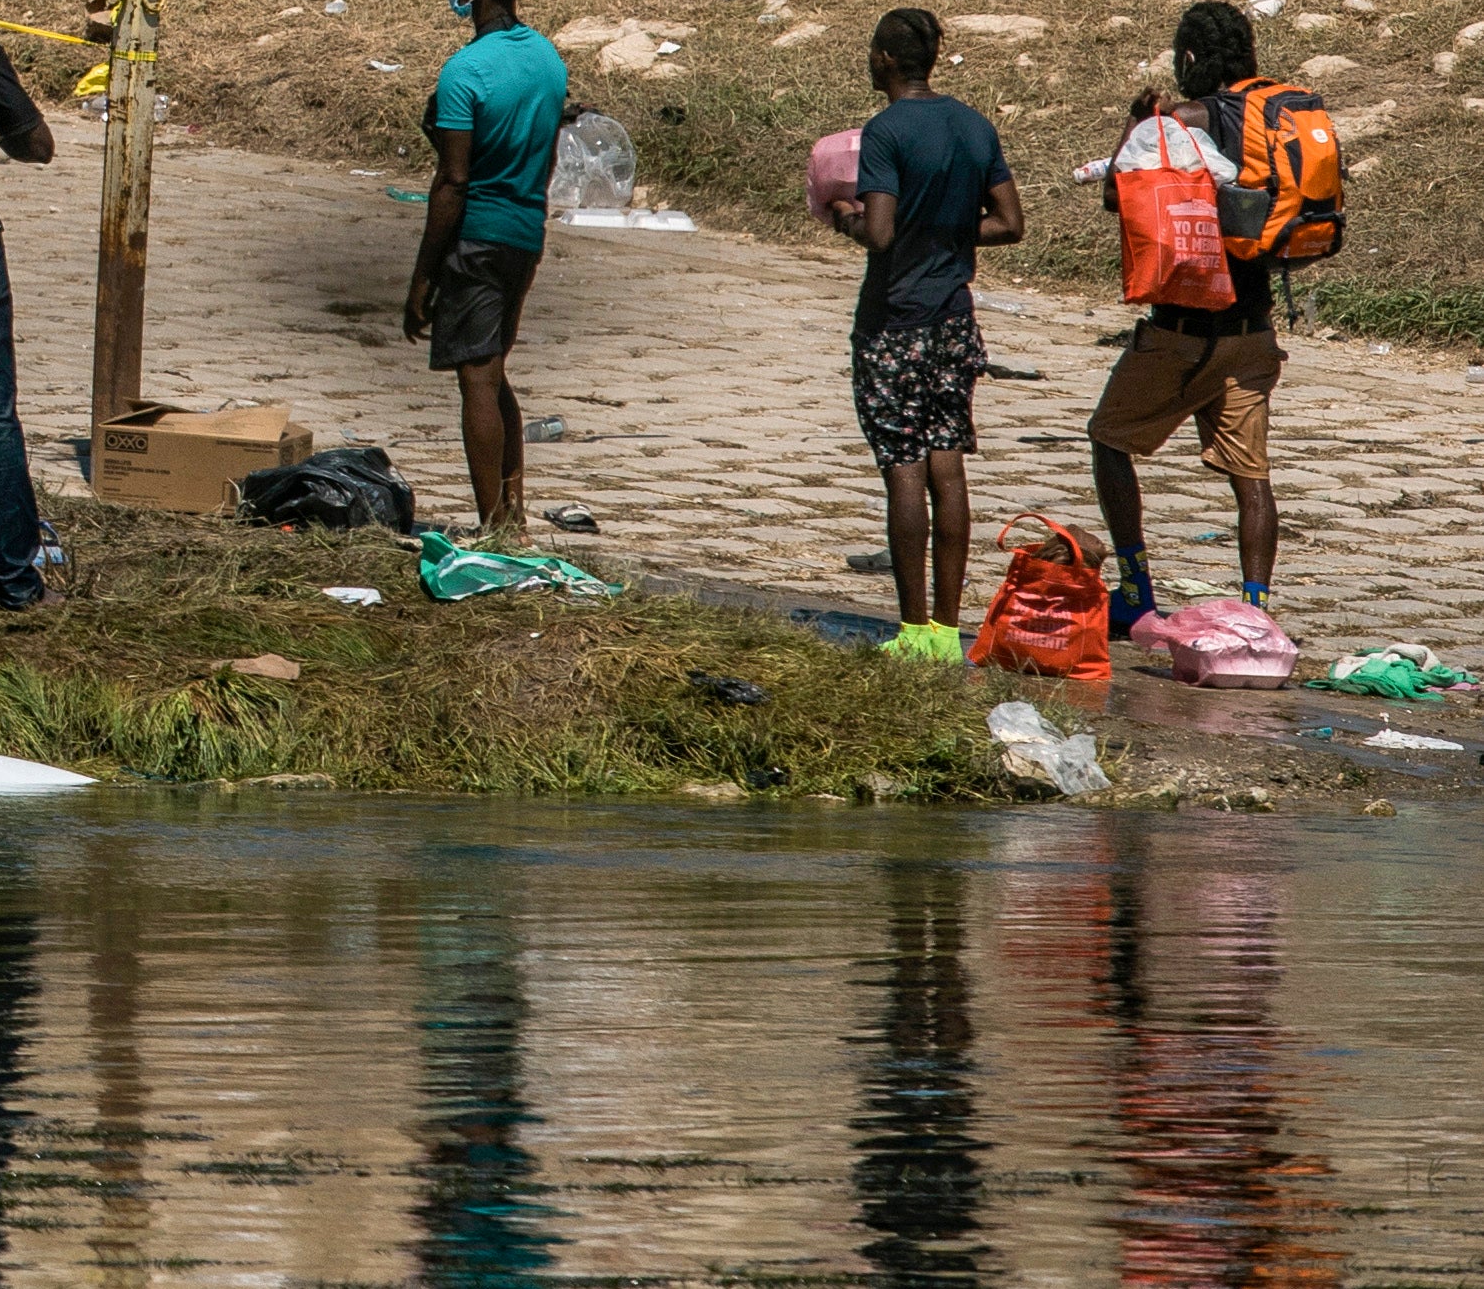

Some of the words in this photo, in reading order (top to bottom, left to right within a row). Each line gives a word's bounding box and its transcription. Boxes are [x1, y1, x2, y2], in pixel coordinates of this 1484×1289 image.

[1172, 220, 1192, 236] YO
[1174, 236, 1189, 252] EL
[106, 434, 148, 451] OXXO
